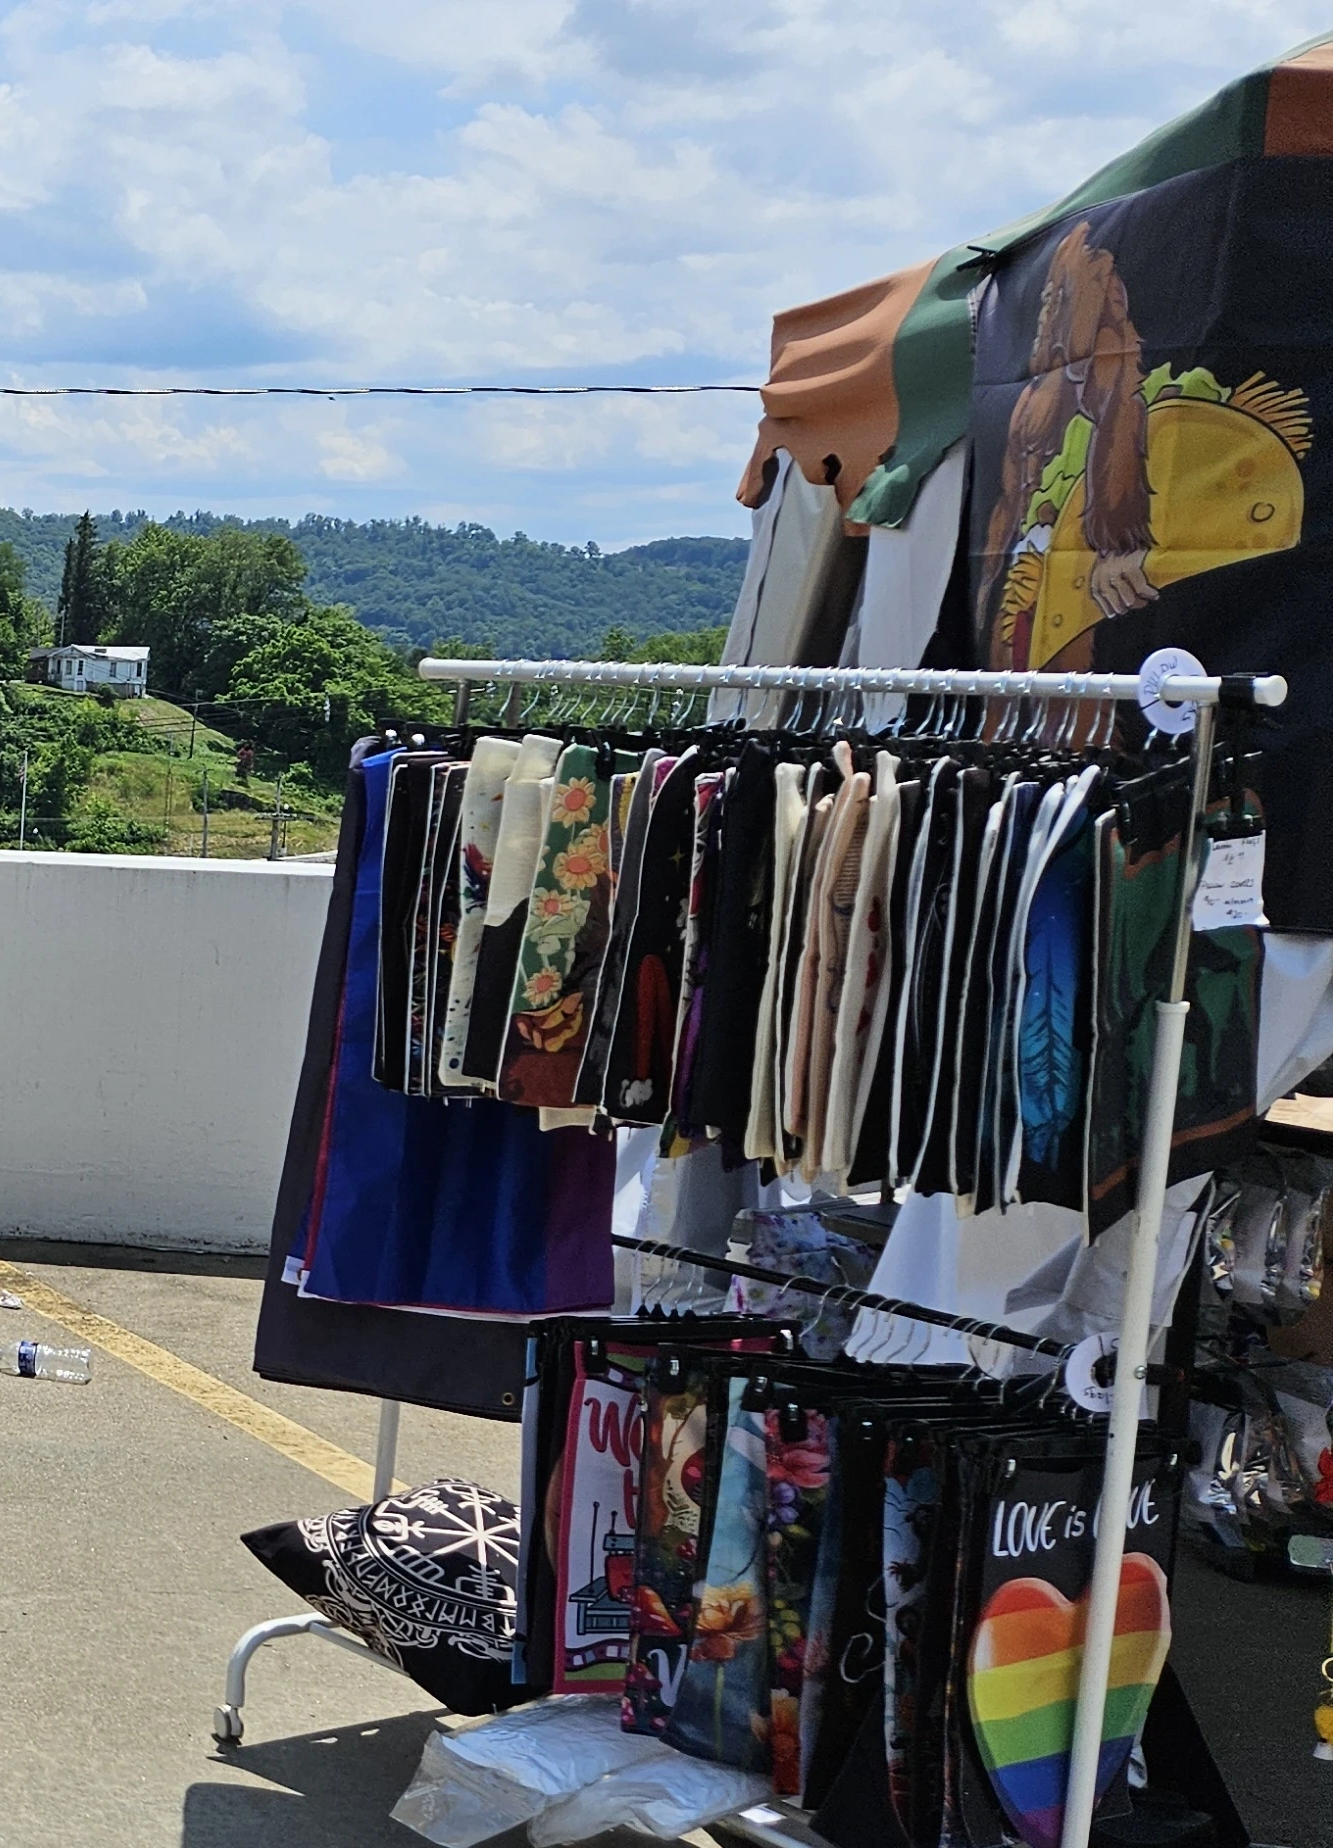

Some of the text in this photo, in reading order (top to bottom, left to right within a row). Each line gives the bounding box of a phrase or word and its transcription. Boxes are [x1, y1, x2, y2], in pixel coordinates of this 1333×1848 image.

[993, 1478, 1160, 1557] LOVE is VE
